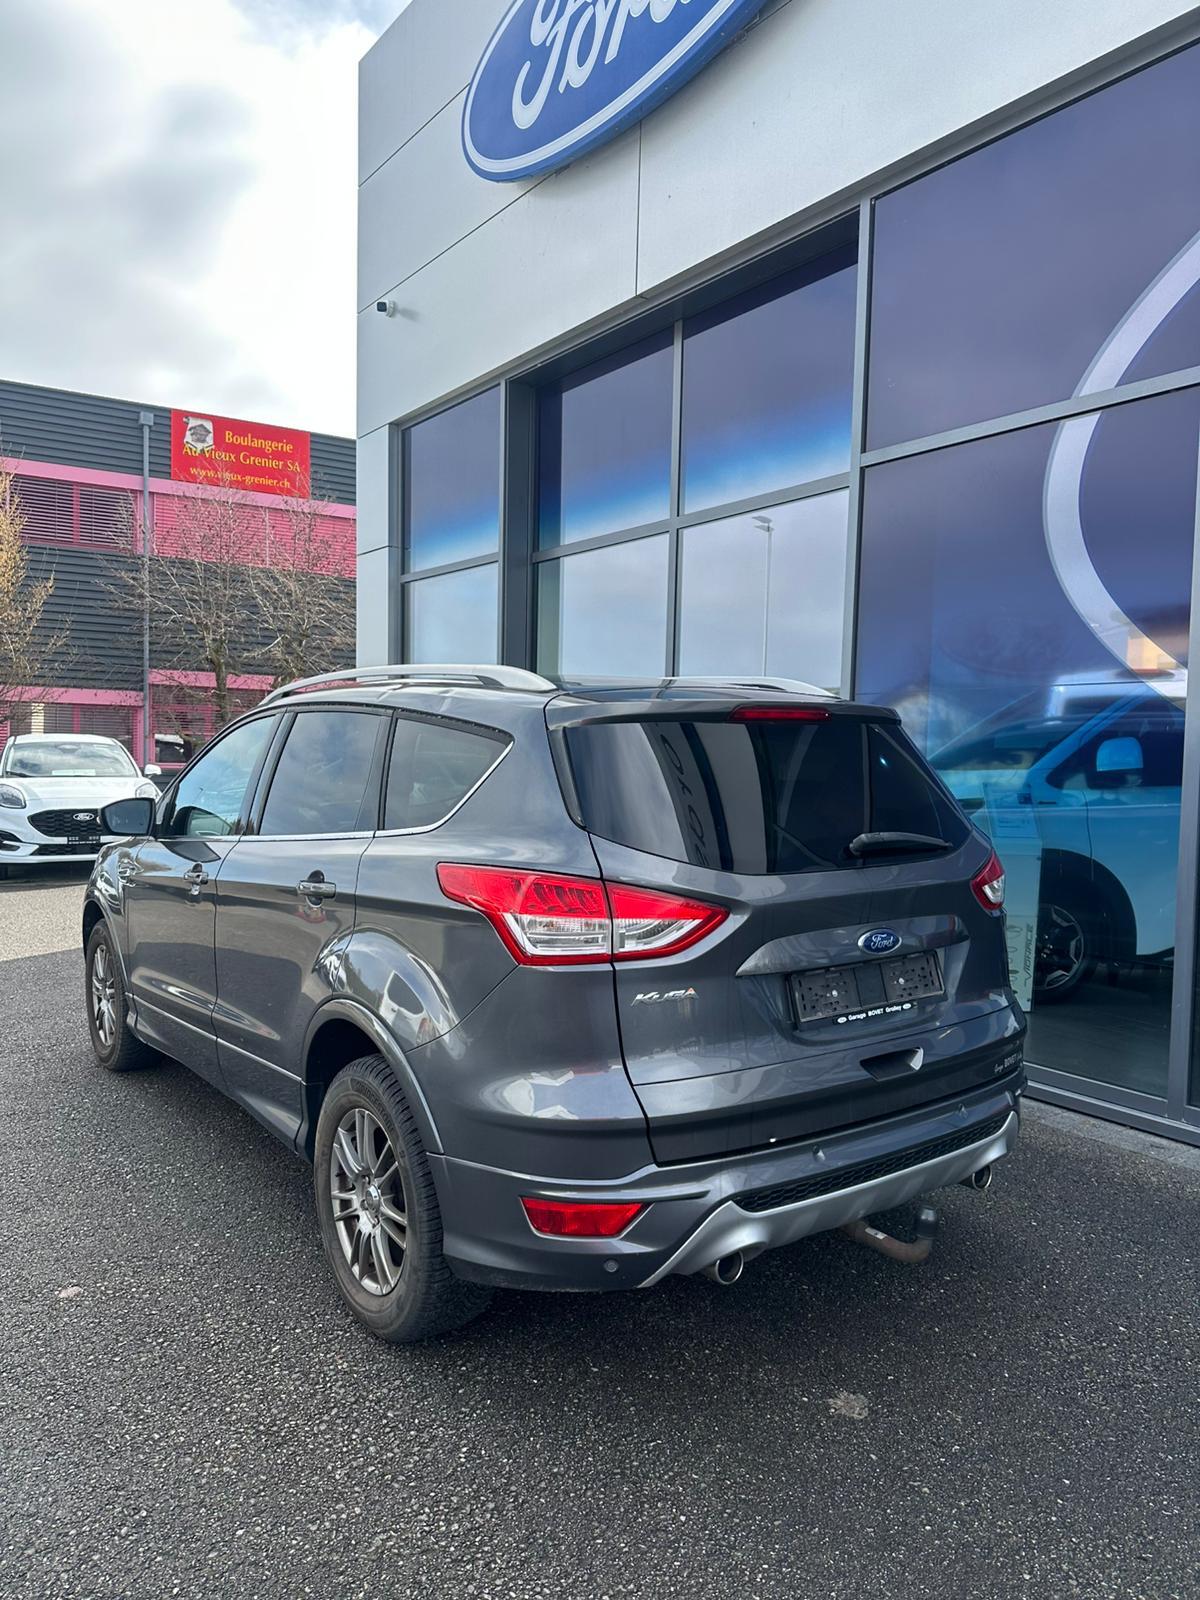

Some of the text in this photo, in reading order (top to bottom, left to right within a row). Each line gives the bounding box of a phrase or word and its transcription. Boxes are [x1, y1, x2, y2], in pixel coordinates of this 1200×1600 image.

[511, 0, 692, 129] For
[225, 431, 293, 453] Boulangerie
[183, 444, 301, 473] Au Vieux Grenier SA
[190, 466, 291, 489] www.vieux-grenier.ch
[870, 933, 894, 949] Ford
[848, 1013, 867, 1021] Garage
[867, 1008, 884, 1017] BOVET
